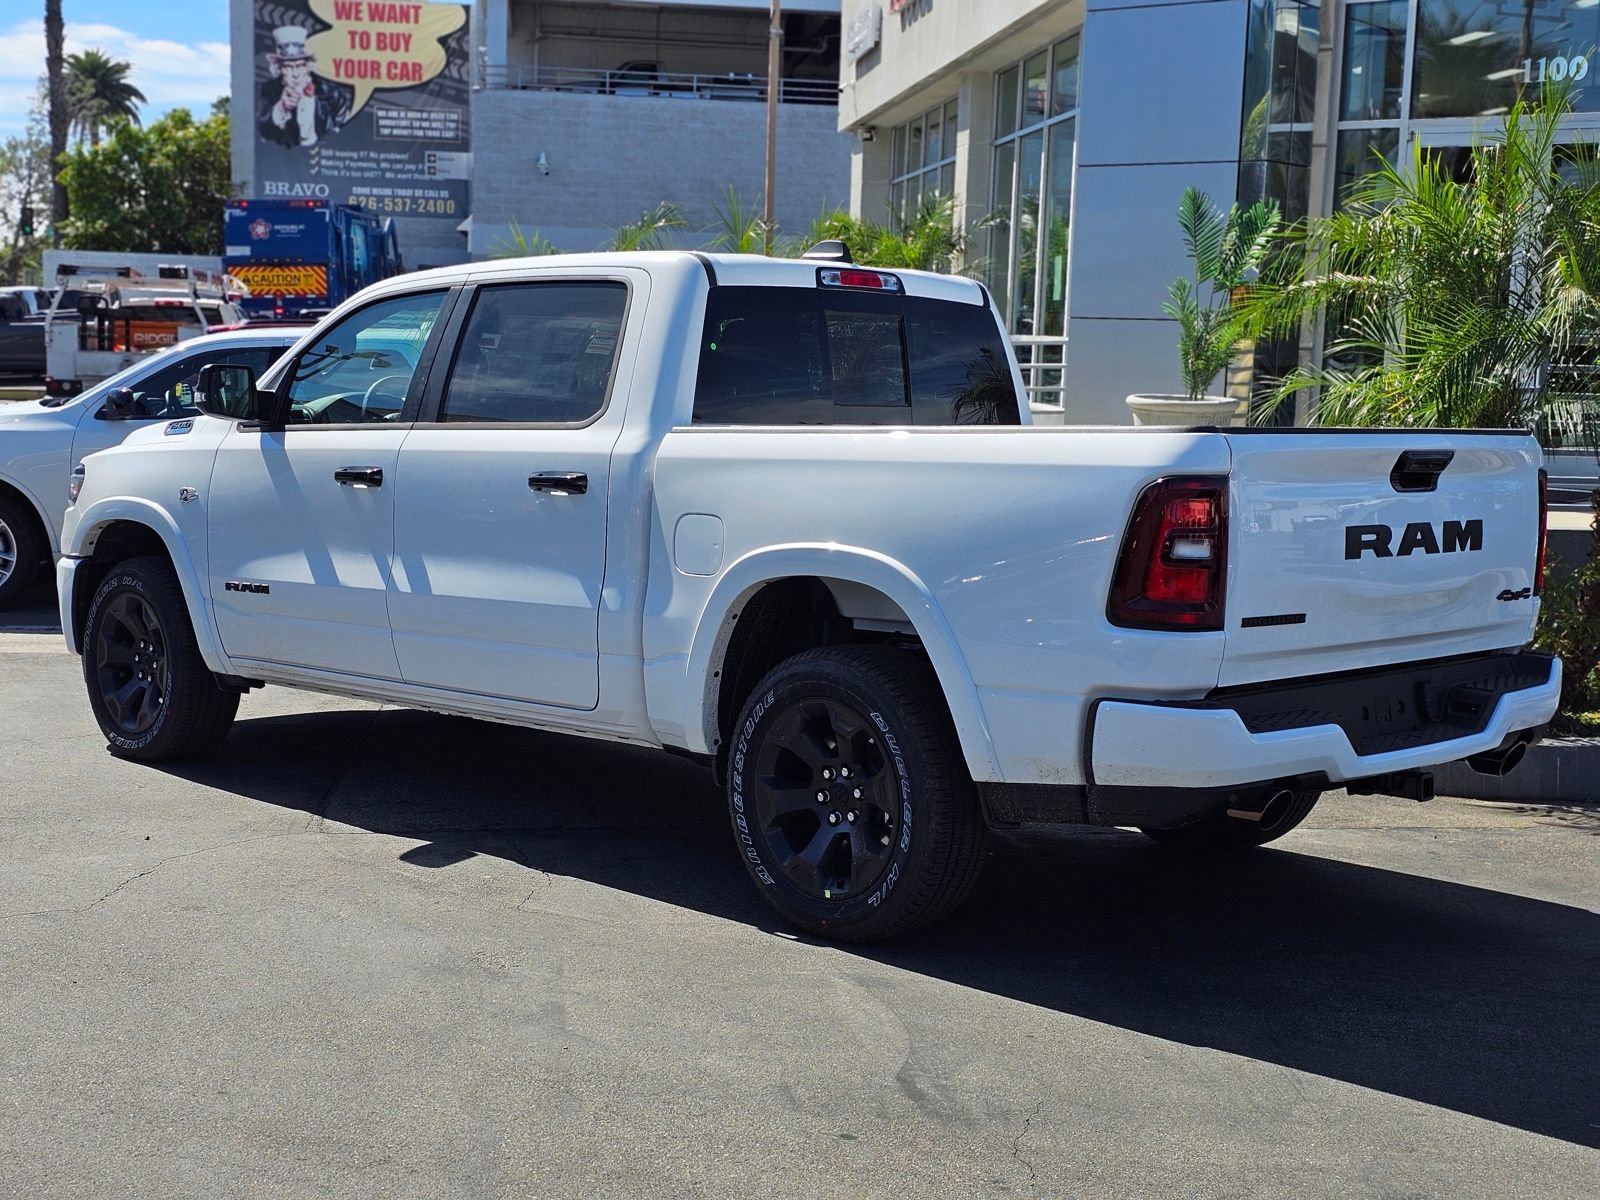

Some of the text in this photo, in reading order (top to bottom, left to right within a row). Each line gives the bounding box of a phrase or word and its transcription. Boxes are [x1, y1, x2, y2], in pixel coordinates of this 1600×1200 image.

[334, 0, 422, 24] WE WANT
[347, 30, 413, 53] TO BUY
[332, 58, 423, 82] YOUR CAR
[1521, 55, 1589, 83] 1100
[264, 181, 329, 197] BRAVO
[352, 187, 371, 195] COME
[372, 187, 392, 196] INSIDE
[394, 188, 413, 196] TODAY
[424, 189, 439, 197] CALL
[348, 195, 455, 214] 626-537-2400
[251, 274, 301, 283] CAUTION
[1344, 519, 1484, 560] RAM
[224, 581, 270, 595] RAM
[83, 576, 144, 650] DUELER H/L
[733, 688, 775, 886] BRIDGESTONE
[868, 711, 912, 908] DUELER H/L
